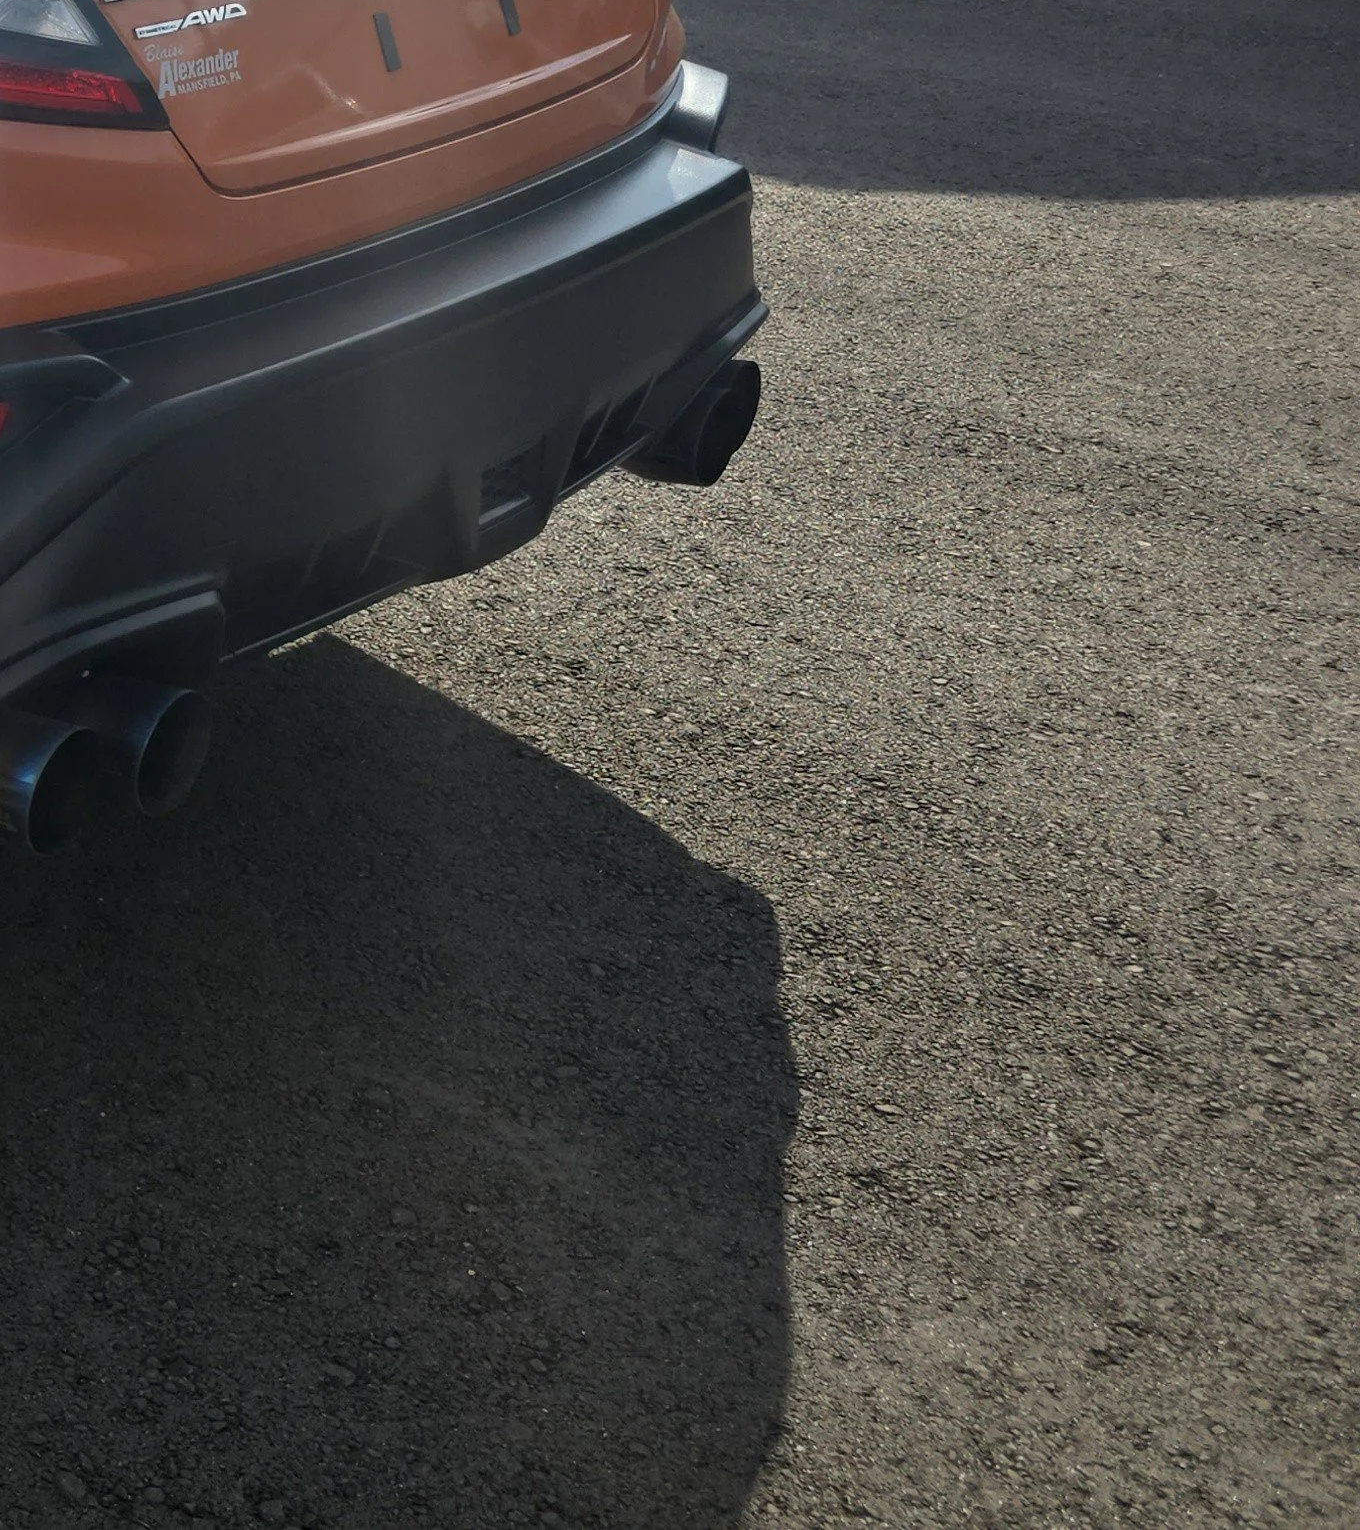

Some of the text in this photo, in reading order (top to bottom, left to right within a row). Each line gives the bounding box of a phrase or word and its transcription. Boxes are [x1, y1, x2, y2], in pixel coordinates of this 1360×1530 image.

[181, 3, 247, 29] AWD
[158, 48, 239, 99] Alexander
[229, 70, 241, 84] PA
